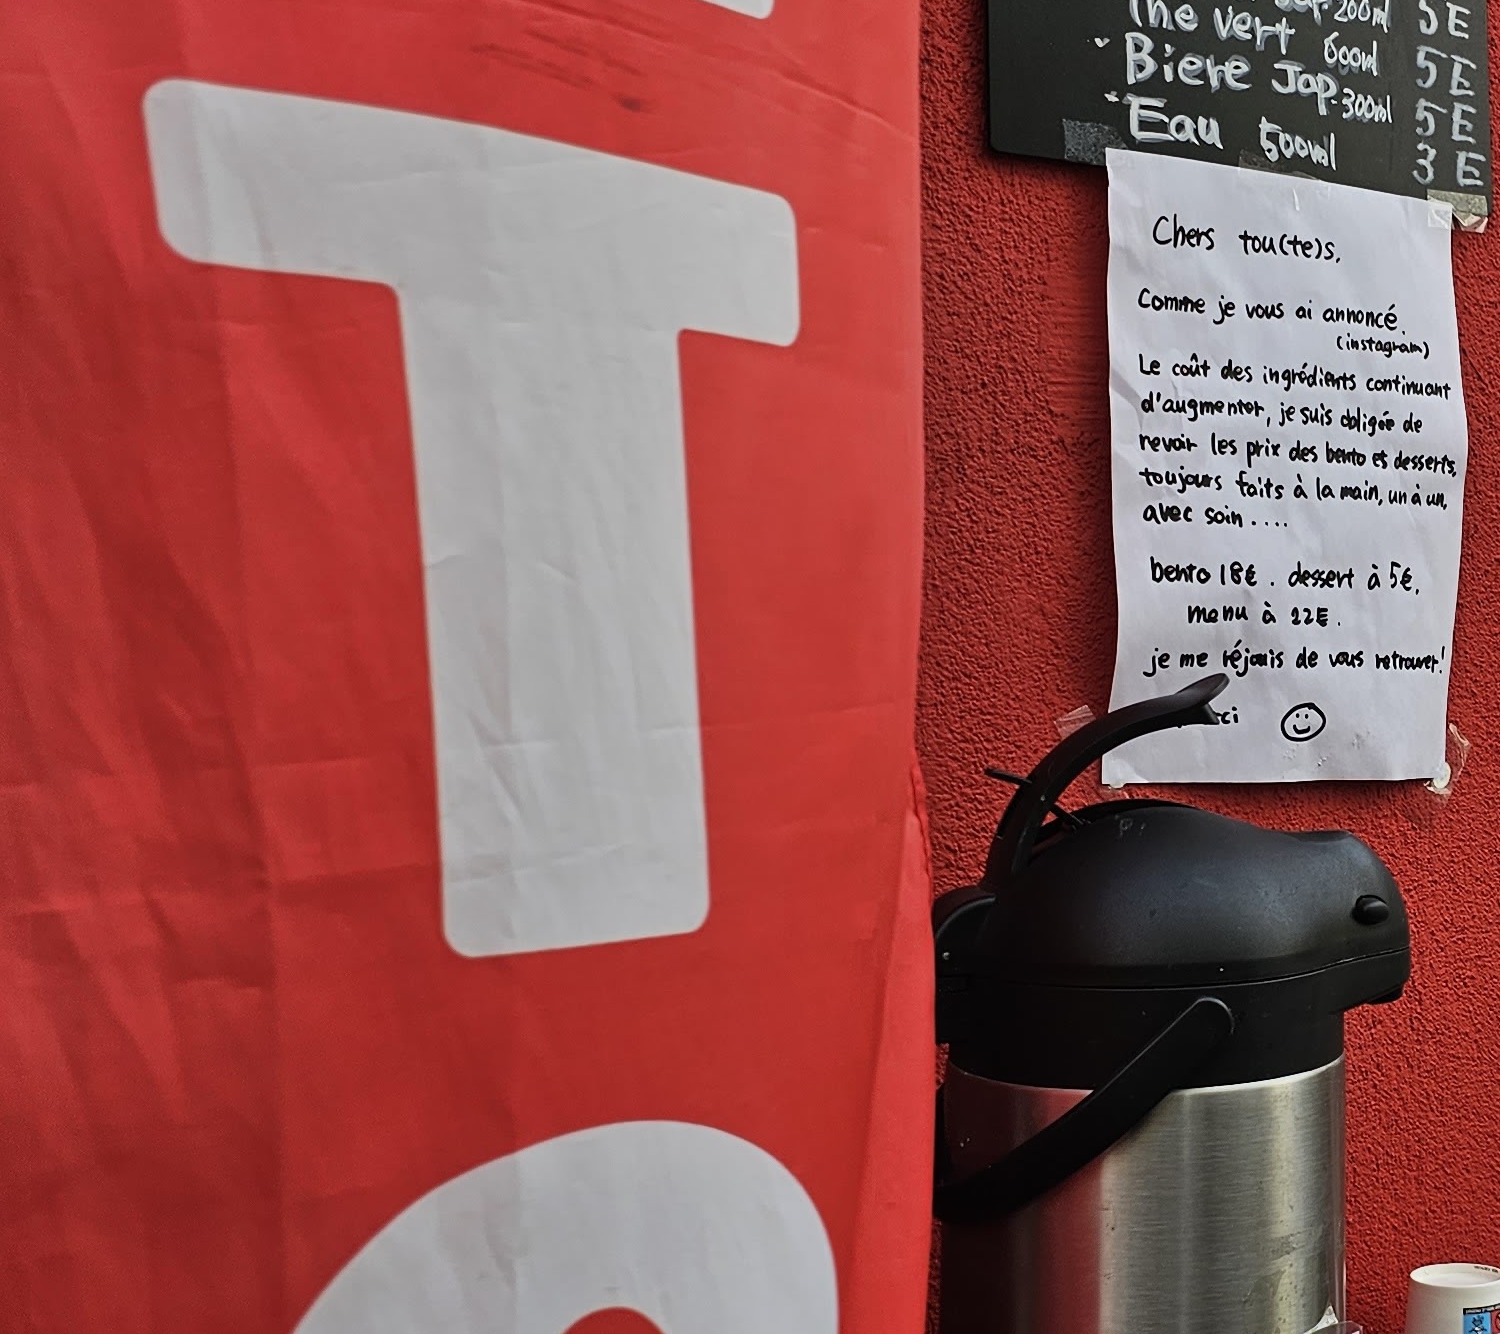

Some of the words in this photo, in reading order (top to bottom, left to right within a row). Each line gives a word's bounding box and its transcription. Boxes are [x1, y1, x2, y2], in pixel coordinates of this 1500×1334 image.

[1214, 6, 1296, 55] vert
[1123, 93, 1223, 149] Eau
[1152, 214, 1215, 250] Chers
[1138, 288, 1206, 314] Comme
[1212, 295, 1236, 325] je
[1246, 301, 1284, 319] vous
[1295, 300, 1312, 319] ai
[1336, 333, 1429, 359] (instagram)
[1138, 354, 1160, 375] Le
[1172, 352, 1211, 377] coût
[1221, 359, 1253, 383] des
[1263, 362, 1357, 392] ingrédients
[1365, 376, 1451, 400] continuant
[1278, 403, 1295, 427] je
[1301, 402, 1333, 427] suis
[1402, 413, 1423, 434] de
[1139, 432, 1197, 452] revoir
[1211, 432, 1238, 456] les
[1246, 437, 1281, 468] prix
[1289, 439, 1318, 463] des
[1325, 444, 1367, 466] bento
[1139, 466, 1223, 495] toujours
[1235, 470, 1284, 500] faits
[1293, 474, 1308, 499] à
[1316, 477, 1335, 499] la
[1388, 489, 1407, 505] un
[1411, 484, 1422, 506] à
[1142, 502, 1192, 524] avec
[1150, 556, 1212, 585] bento
[1288, 561, 1355, 589] dessert
[1367, 564, 1381, 590] à
[1188, 603, 1249, 624] menu
[1262, 601, 1276, 625] à
[1142, 648, 1170, 677] je
[1180, 649, 1209, 668] me
[1295, 646, 1318, 669] de
[1329, 649, 1364, 668] vous
